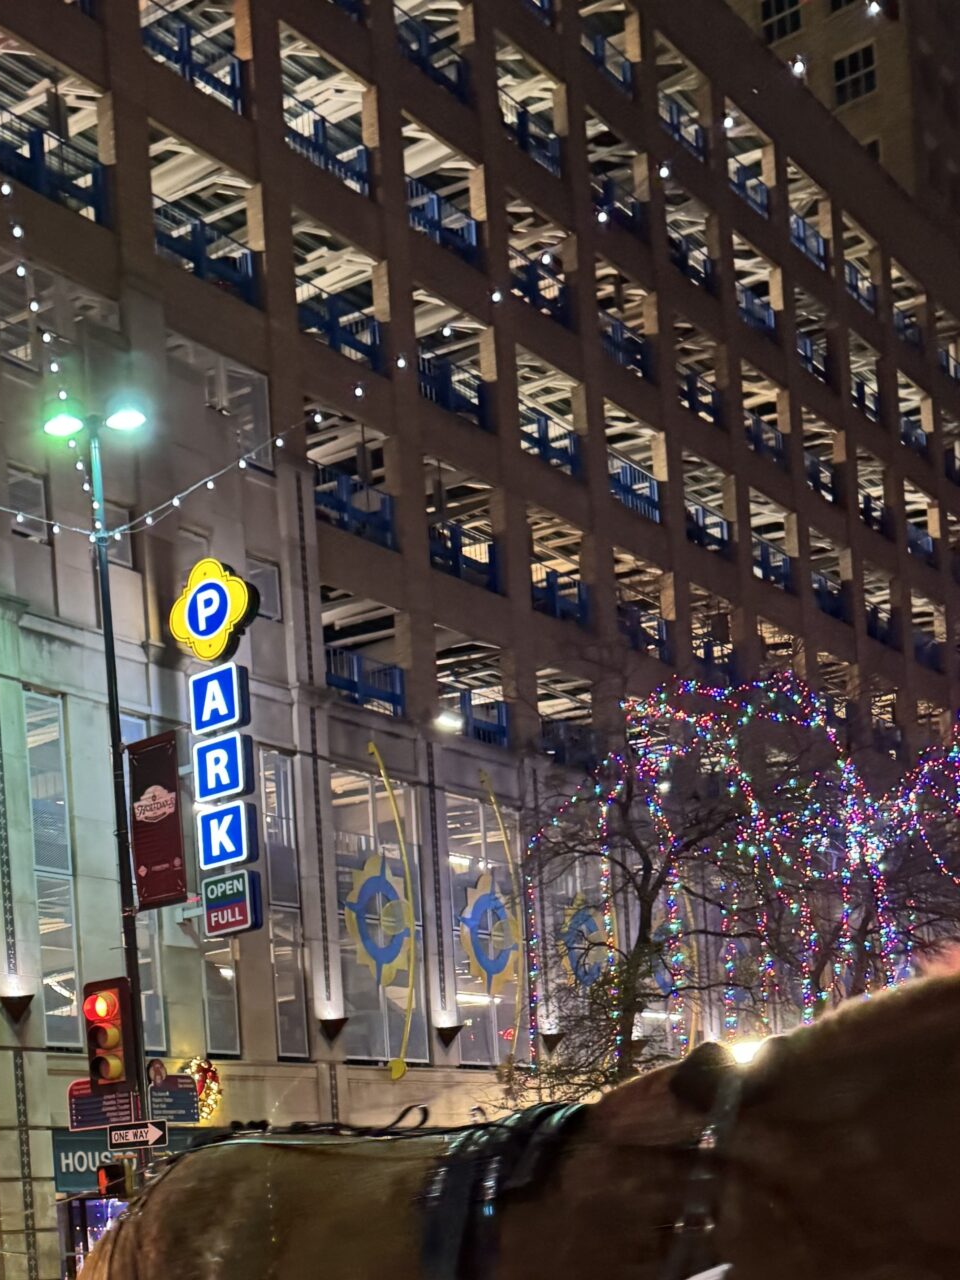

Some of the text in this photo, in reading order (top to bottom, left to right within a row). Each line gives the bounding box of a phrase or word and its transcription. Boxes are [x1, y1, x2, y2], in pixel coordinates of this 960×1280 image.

[195, 588, 237, 856] PARK
[206, 878, 244, 900] OPEN
[209, 906, 244, 927] FULL
[113, 1129, 149, 1142] ONE WAY
